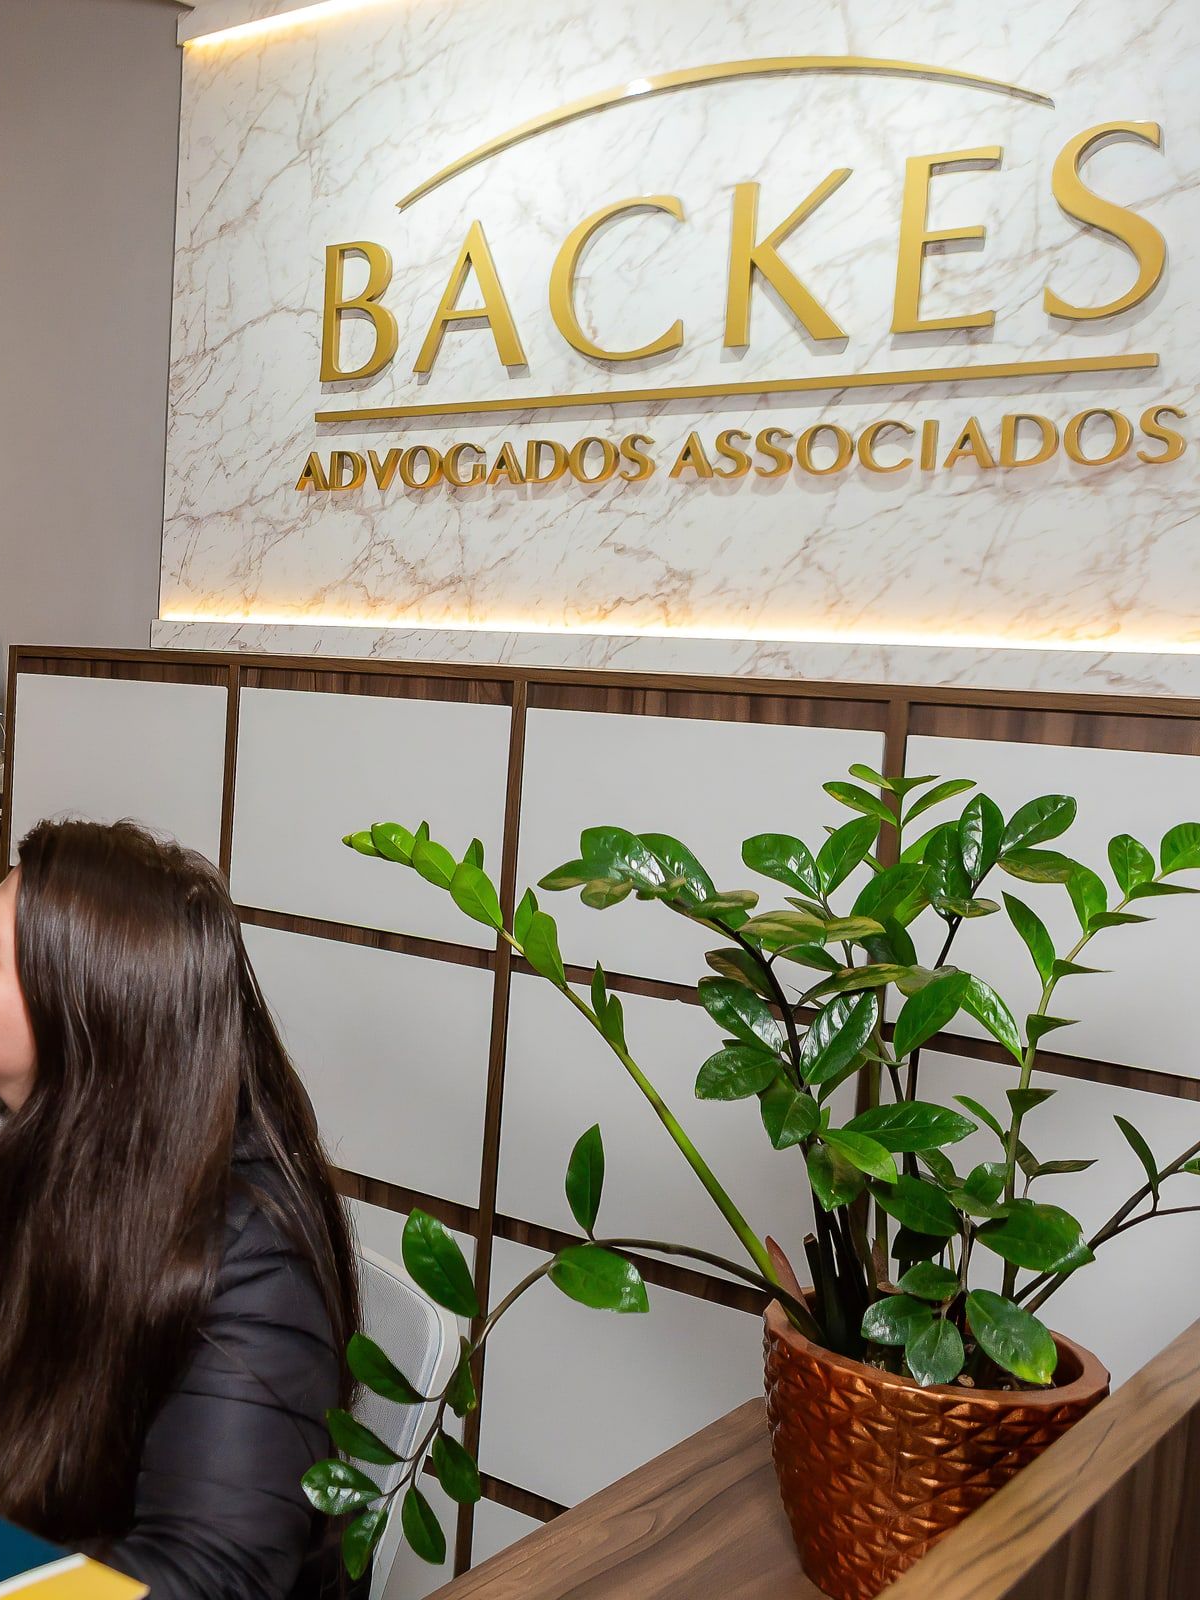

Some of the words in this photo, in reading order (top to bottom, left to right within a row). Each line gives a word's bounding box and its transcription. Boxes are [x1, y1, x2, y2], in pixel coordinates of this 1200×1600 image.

[320, 120, 1167, 383] BACKES
[296, 433, 657, 494] ADVOGADOS
[668, 405, 1189, 480] ASSOCIADOS
